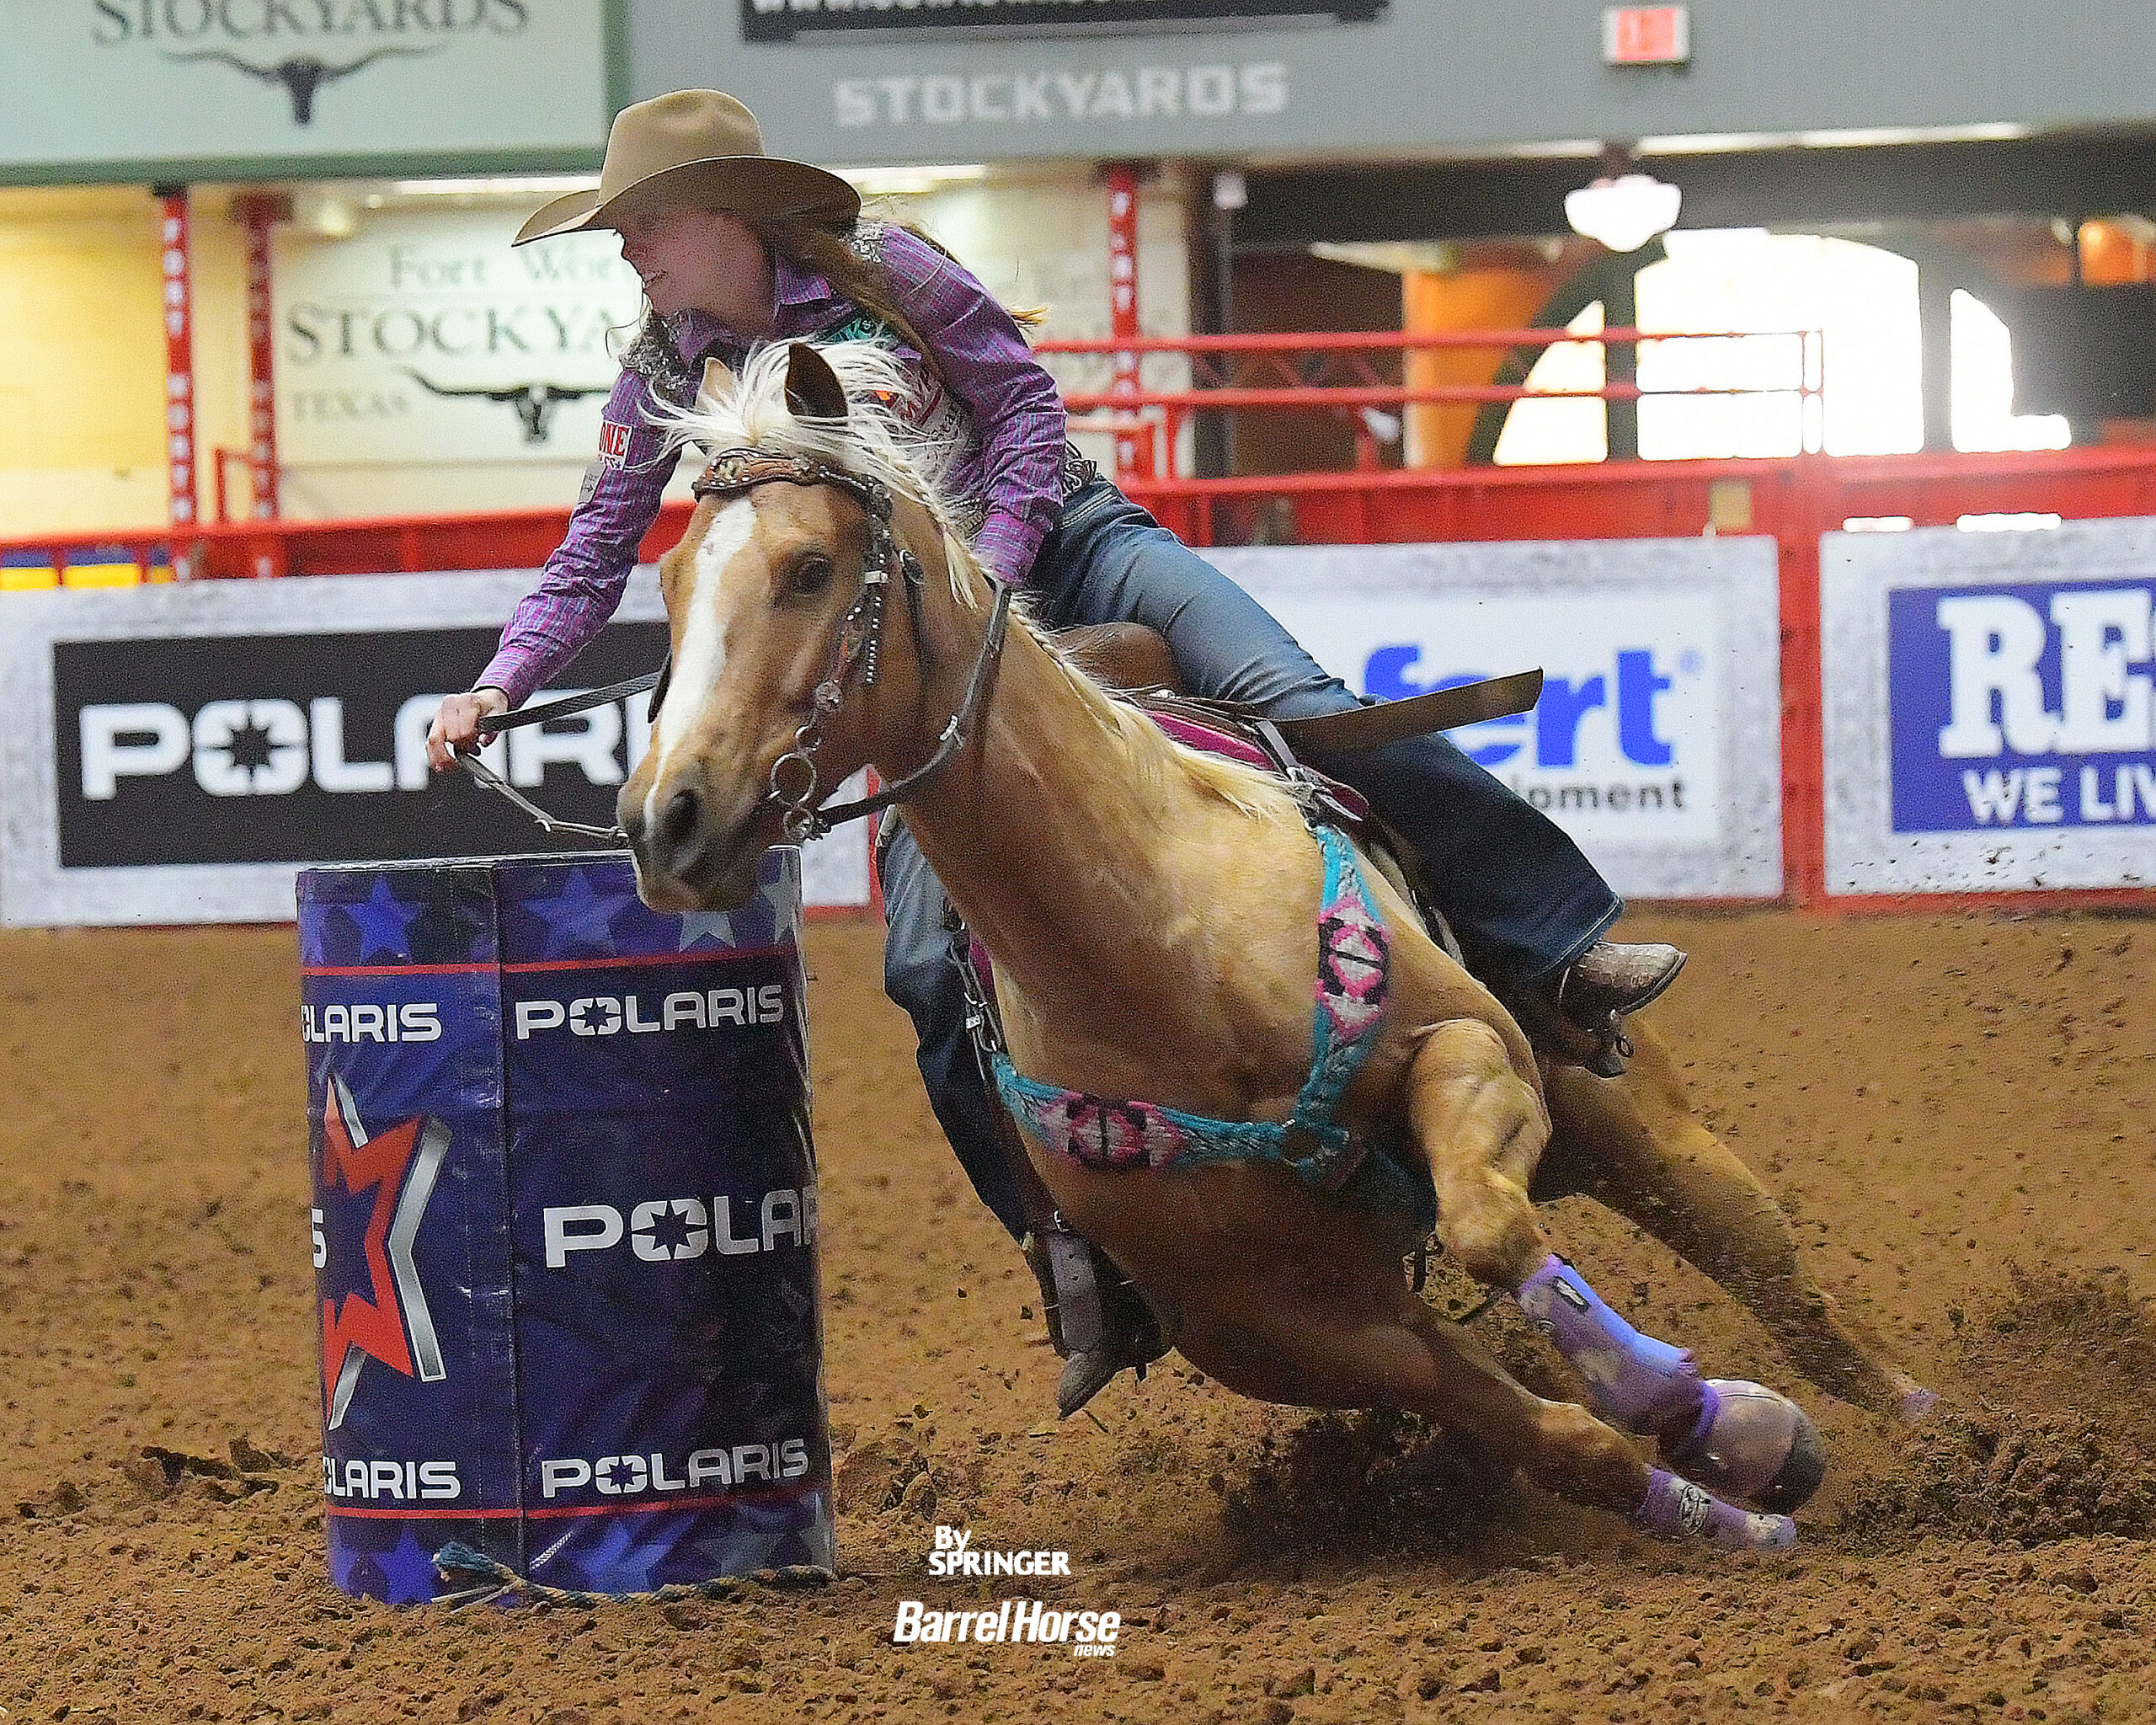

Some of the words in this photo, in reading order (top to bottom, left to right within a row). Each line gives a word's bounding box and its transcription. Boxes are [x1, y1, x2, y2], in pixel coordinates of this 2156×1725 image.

[835, 62, 1287, 126] STOCKYARDS
[387, 243, 488, 286] Fort
[1938, 590, 2156, 757] RE
[1963, 767, 2063, 823] WE
[515, 985, 782, 1040] POLARIS
[542, 1439, 808, 1498] POLARIS
